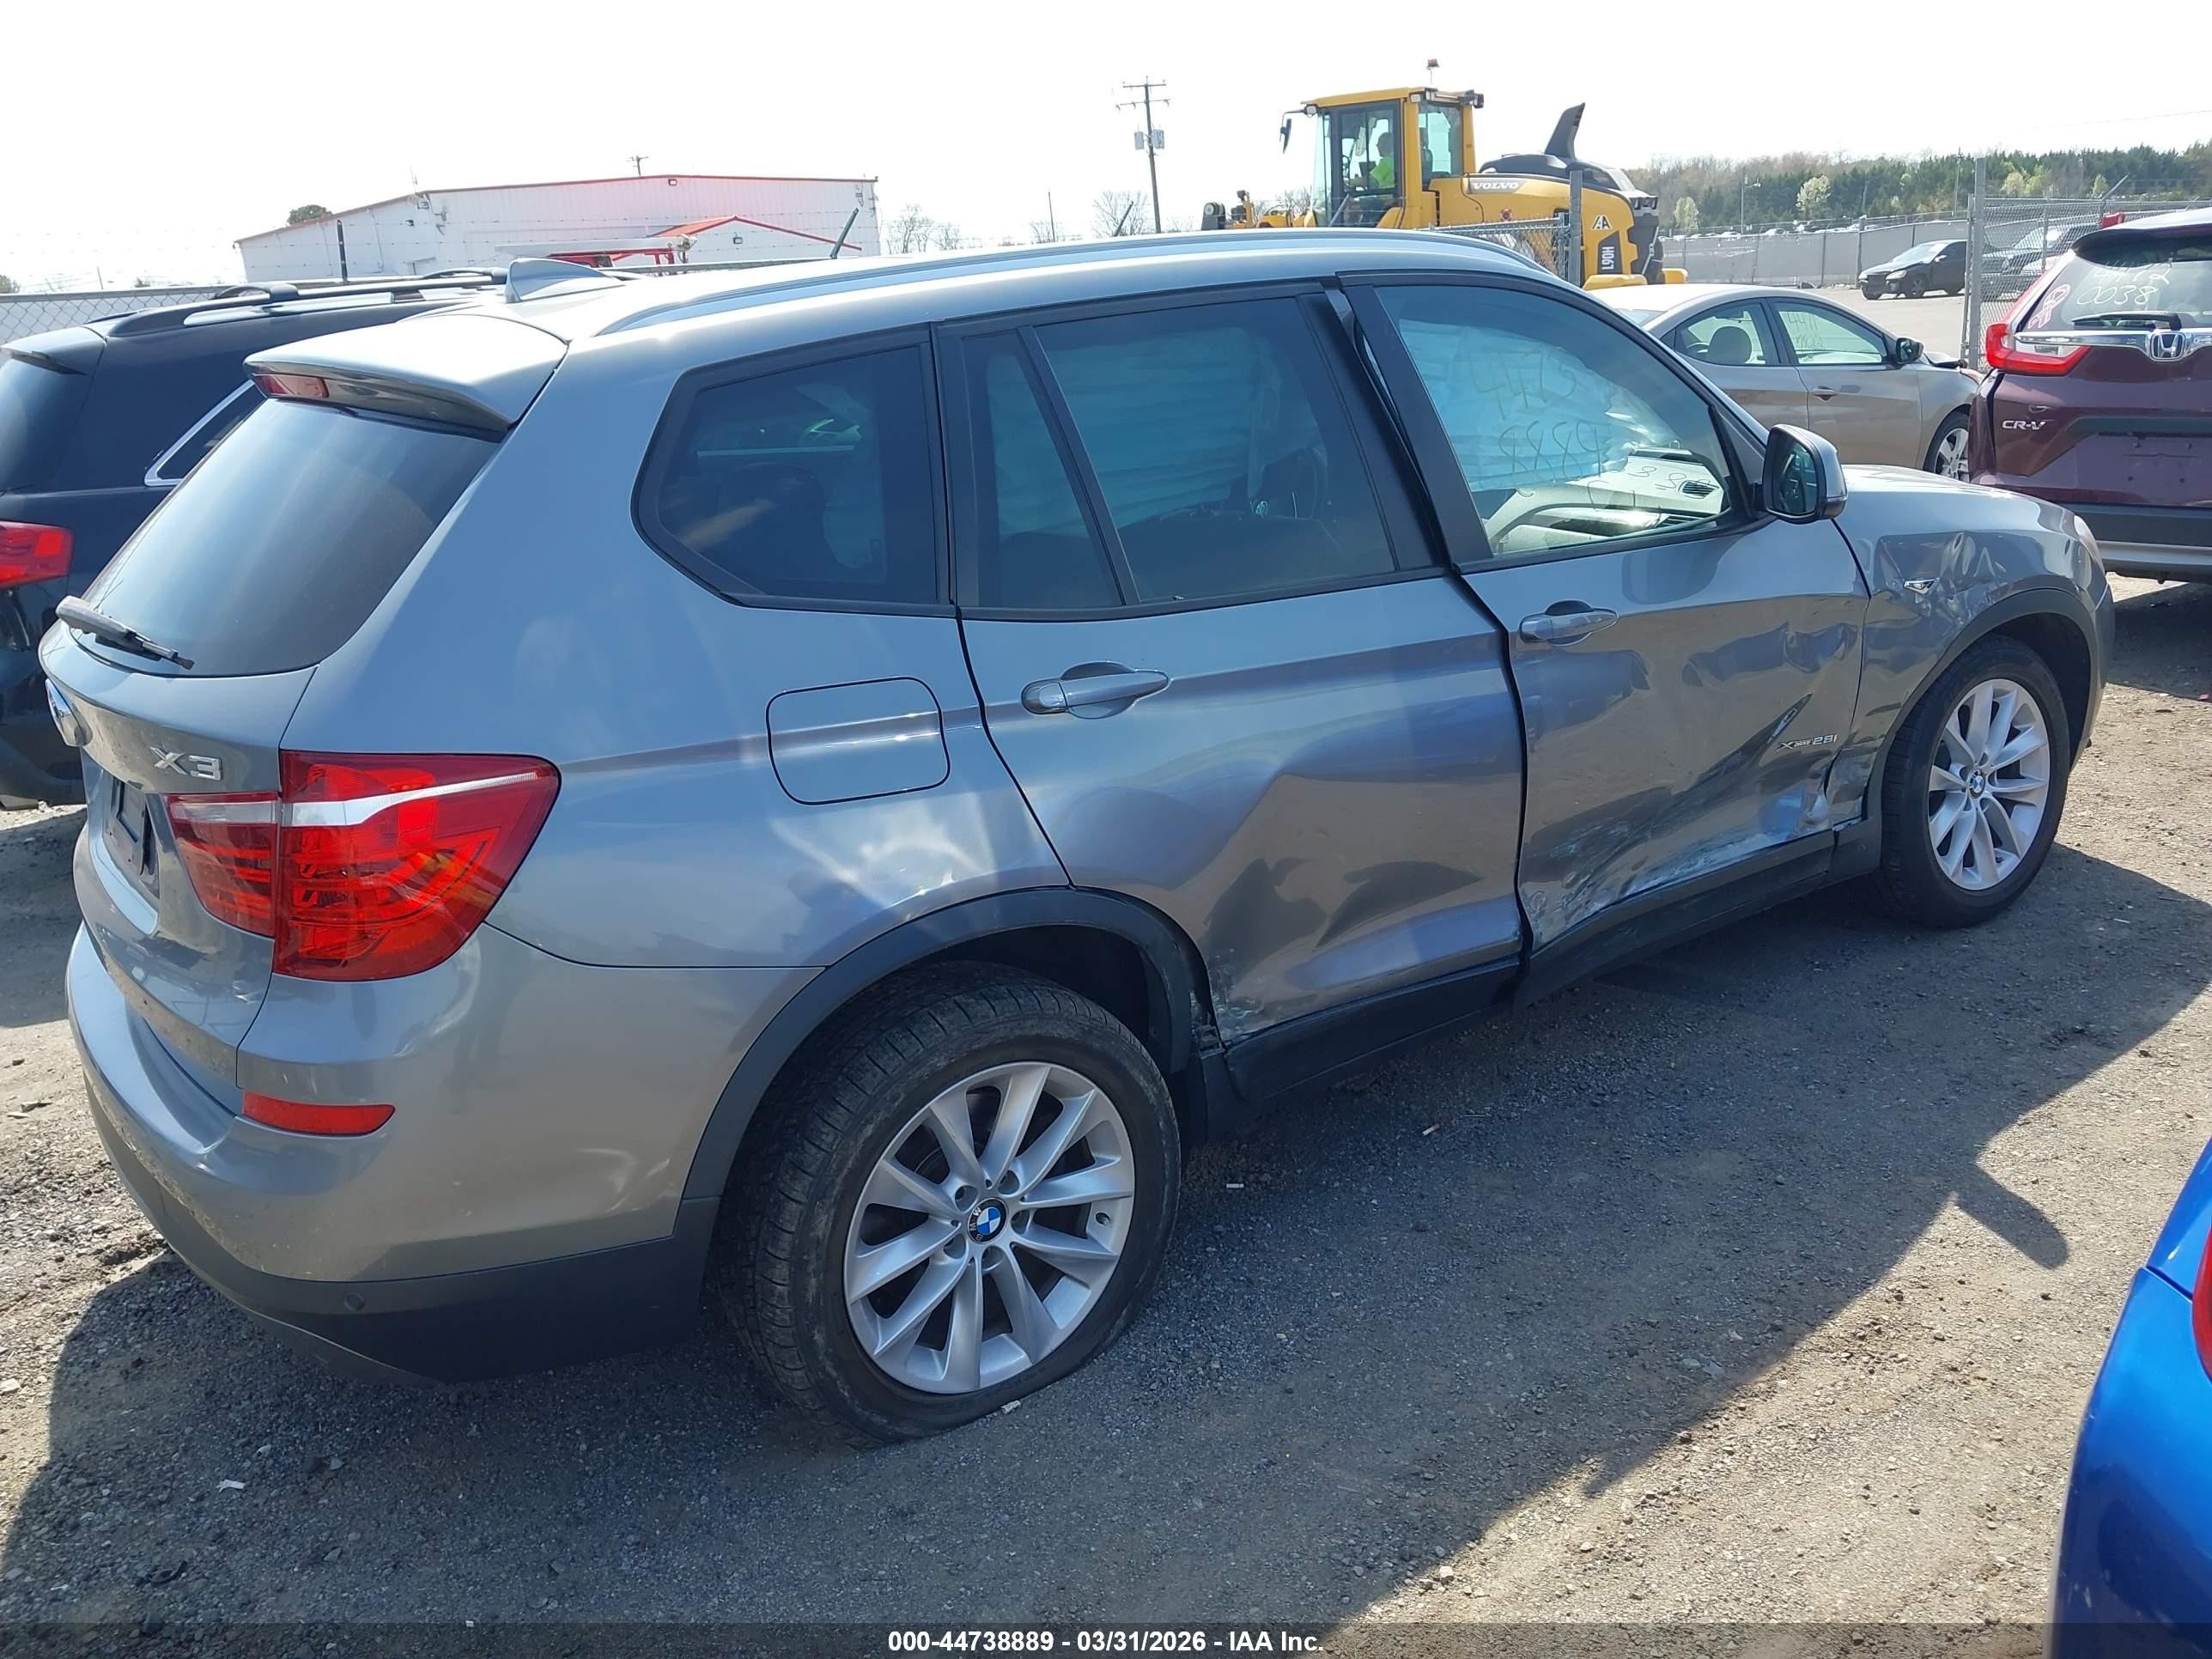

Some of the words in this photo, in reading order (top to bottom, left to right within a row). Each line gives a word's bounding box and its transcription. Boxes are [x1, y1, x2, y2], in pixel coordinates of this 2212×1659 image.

[1601, 246, 1615, 270] L90H
[2076, 285, 2160, 306] 0038
[2002, 420, 2046, 430] CR-V
[1498, 419, 1603, 498] 8889
[149, 746, 222, 781] X3
